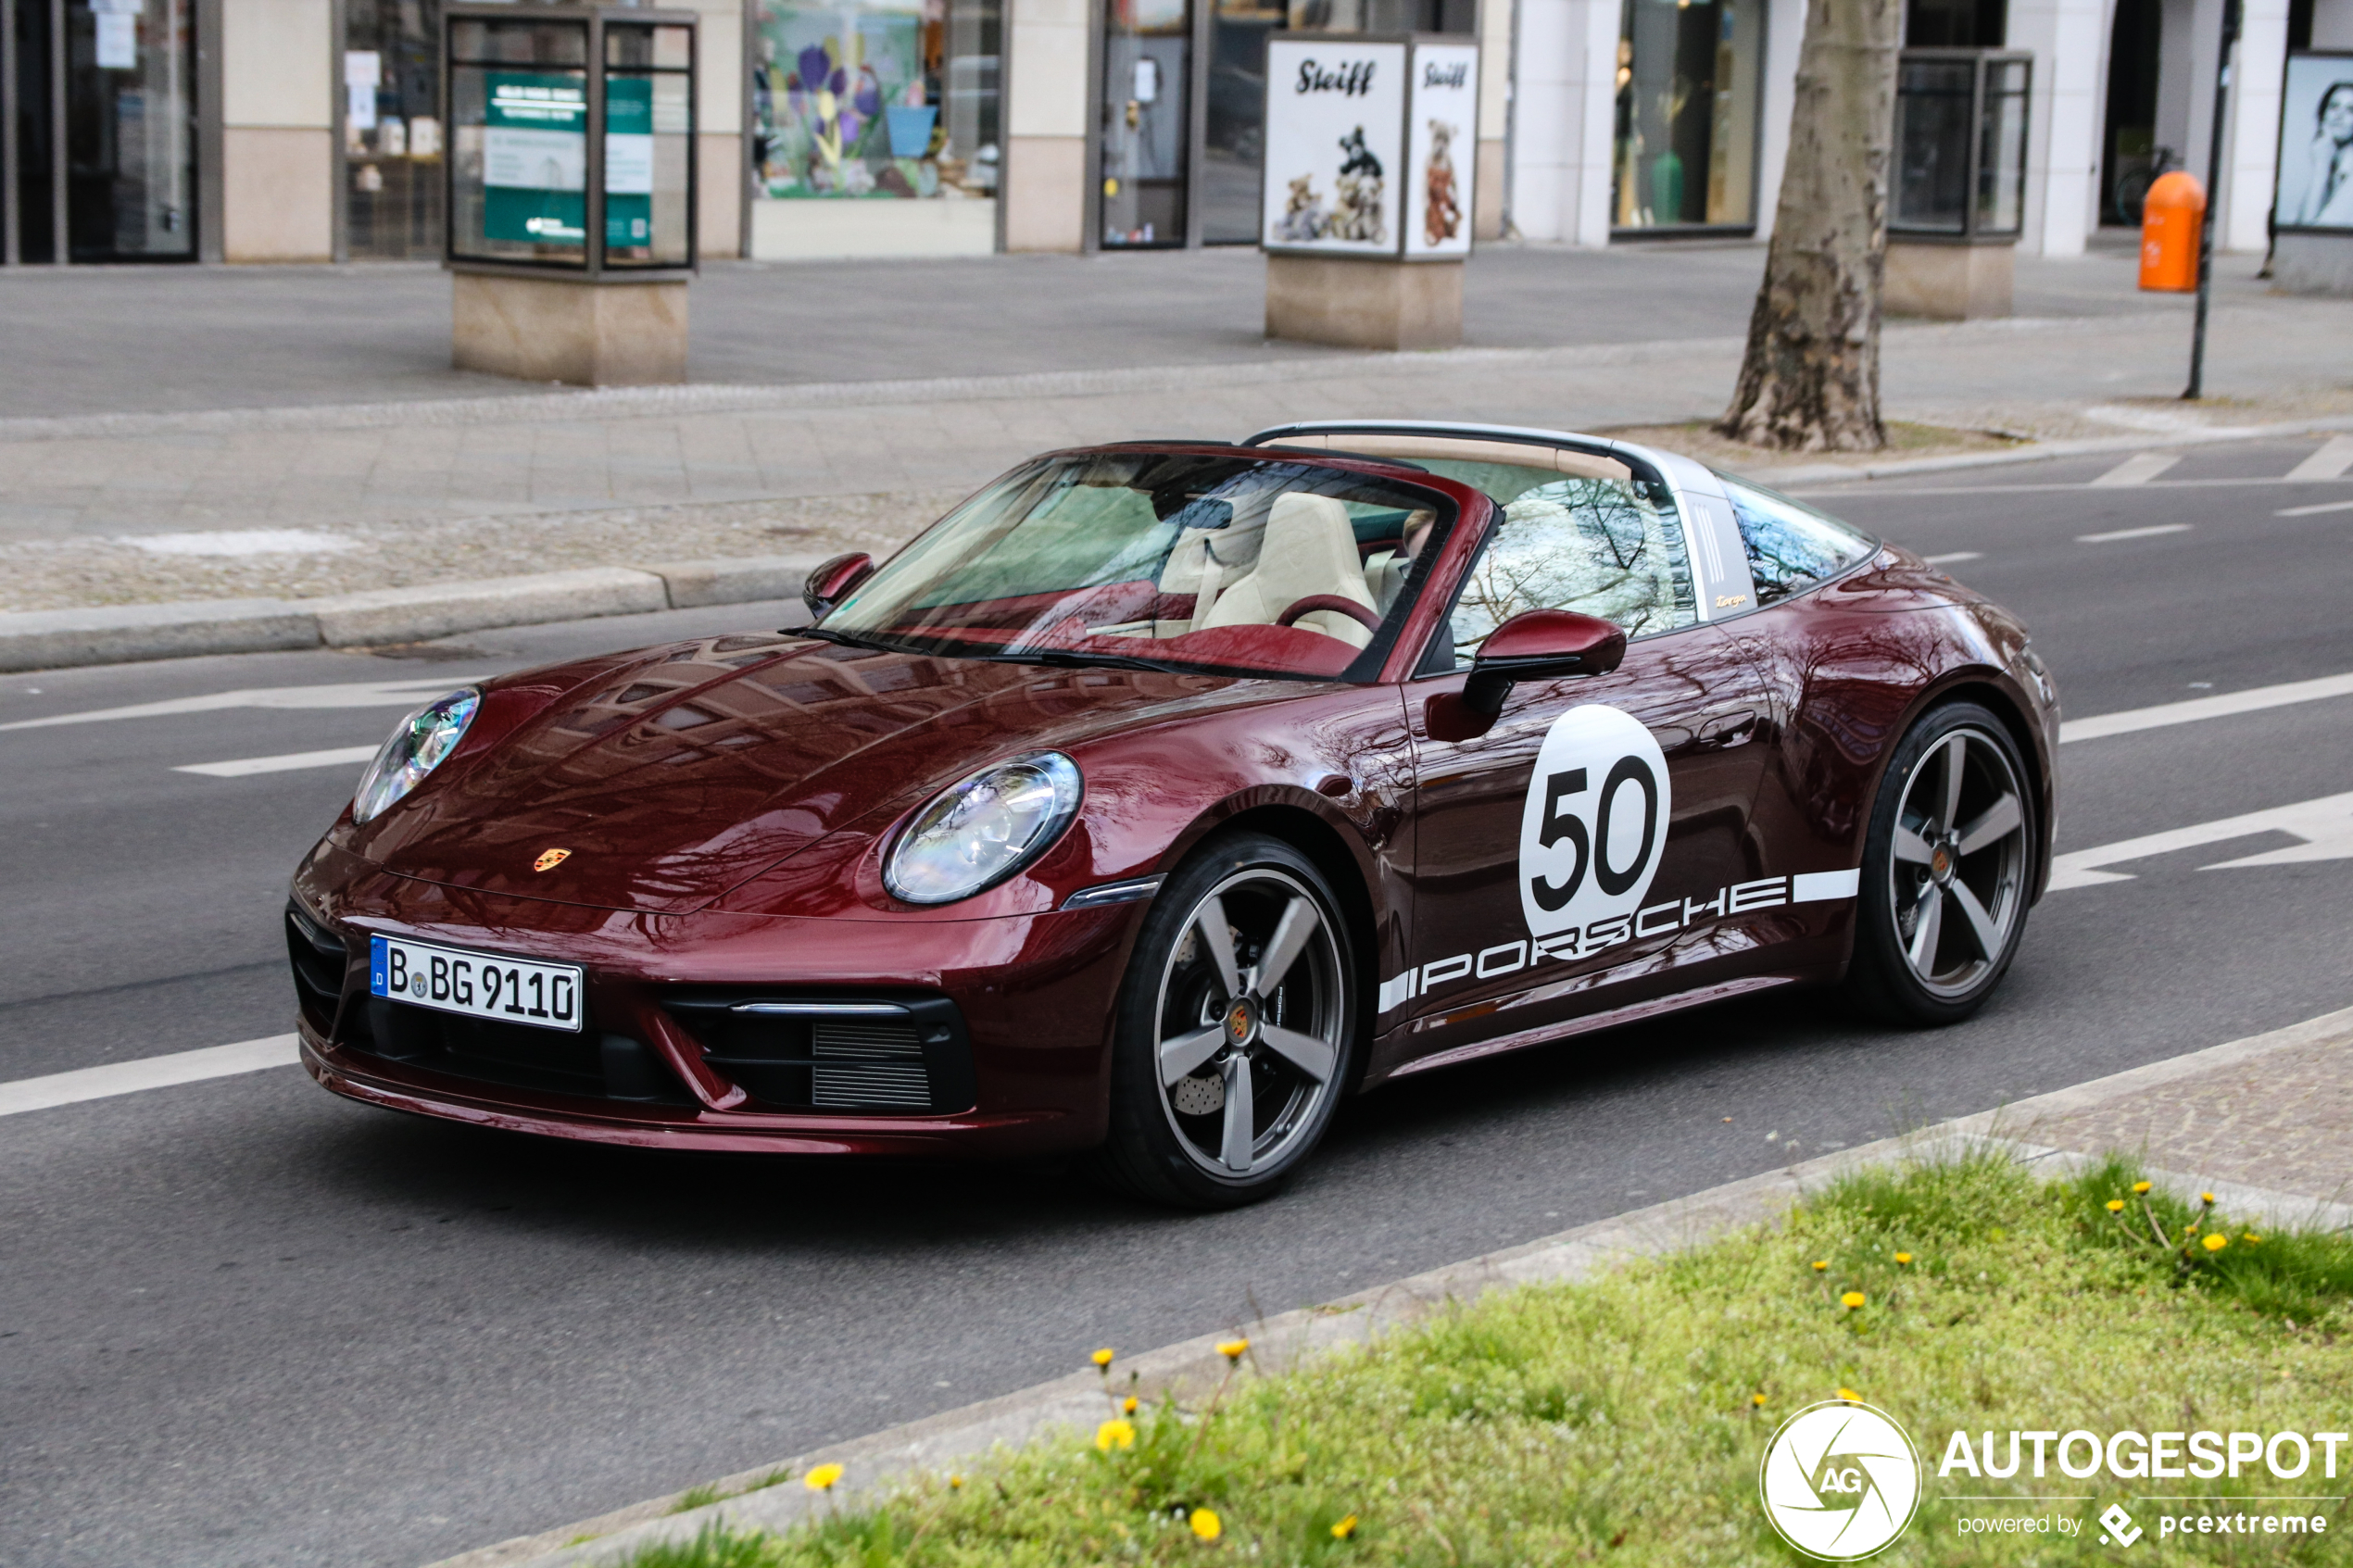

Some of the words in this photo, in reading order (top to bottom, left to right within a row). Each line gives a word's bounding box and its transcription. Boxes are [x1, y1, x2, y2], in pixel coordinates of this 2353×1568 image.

[1296, 58, 1377, 96] Steiff
[1424, 60, 1468, 90] Steiff
[1530, 755, 1658, 912] 50
[1420, 875, 1787, 996] PORSCHE
[376, 972, 384, 985] D
[390, 947, 409, 993] B
[431, 955, 473, 1007] BG
[482, 965, 573, 1021] 9110
